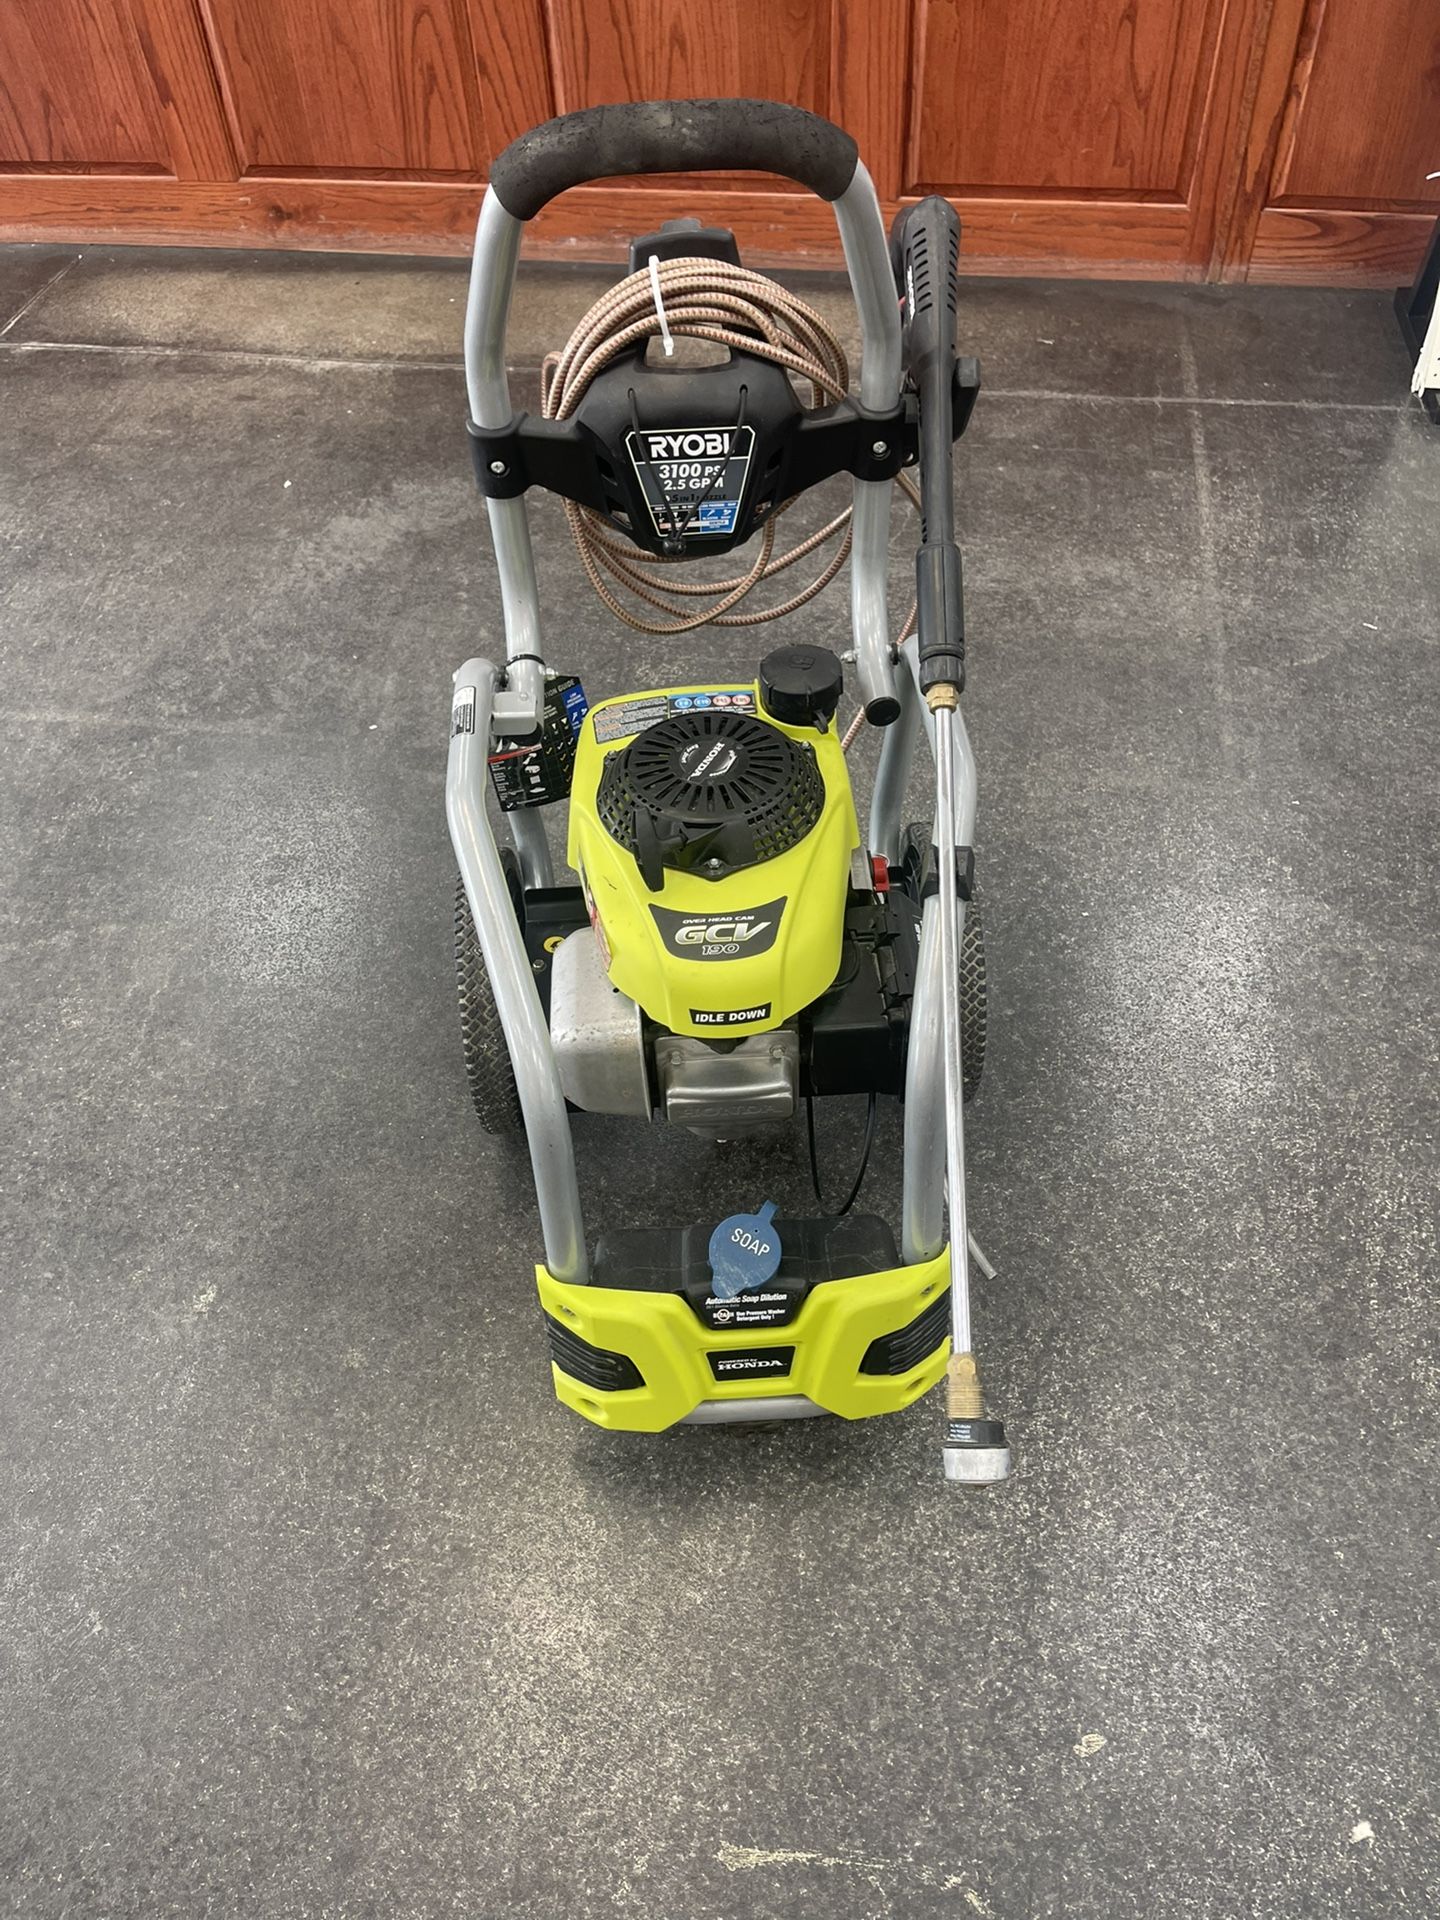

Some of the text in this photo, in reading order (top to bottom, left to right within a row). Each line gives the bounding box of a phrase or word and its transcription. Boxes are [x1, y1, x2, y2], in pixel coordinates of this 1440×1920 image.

[648, 433, 730, 458] RYOBI
[659, 463, 702, 479] 3100
[664, 478, 686, 491] 2.5
[690, 742, 725, 777] HONDA
[675, 922, 771, 945] GCV
[702, 943, 740, 956] 190
[695, 1009, 766, 1023] IDLE DOWN
[731, 1228, 770, 1257] SOAP
[705, 1293, 788, 1305] Automatic Soap Dilution
[718, 1360, 783, 1371] HONDA
